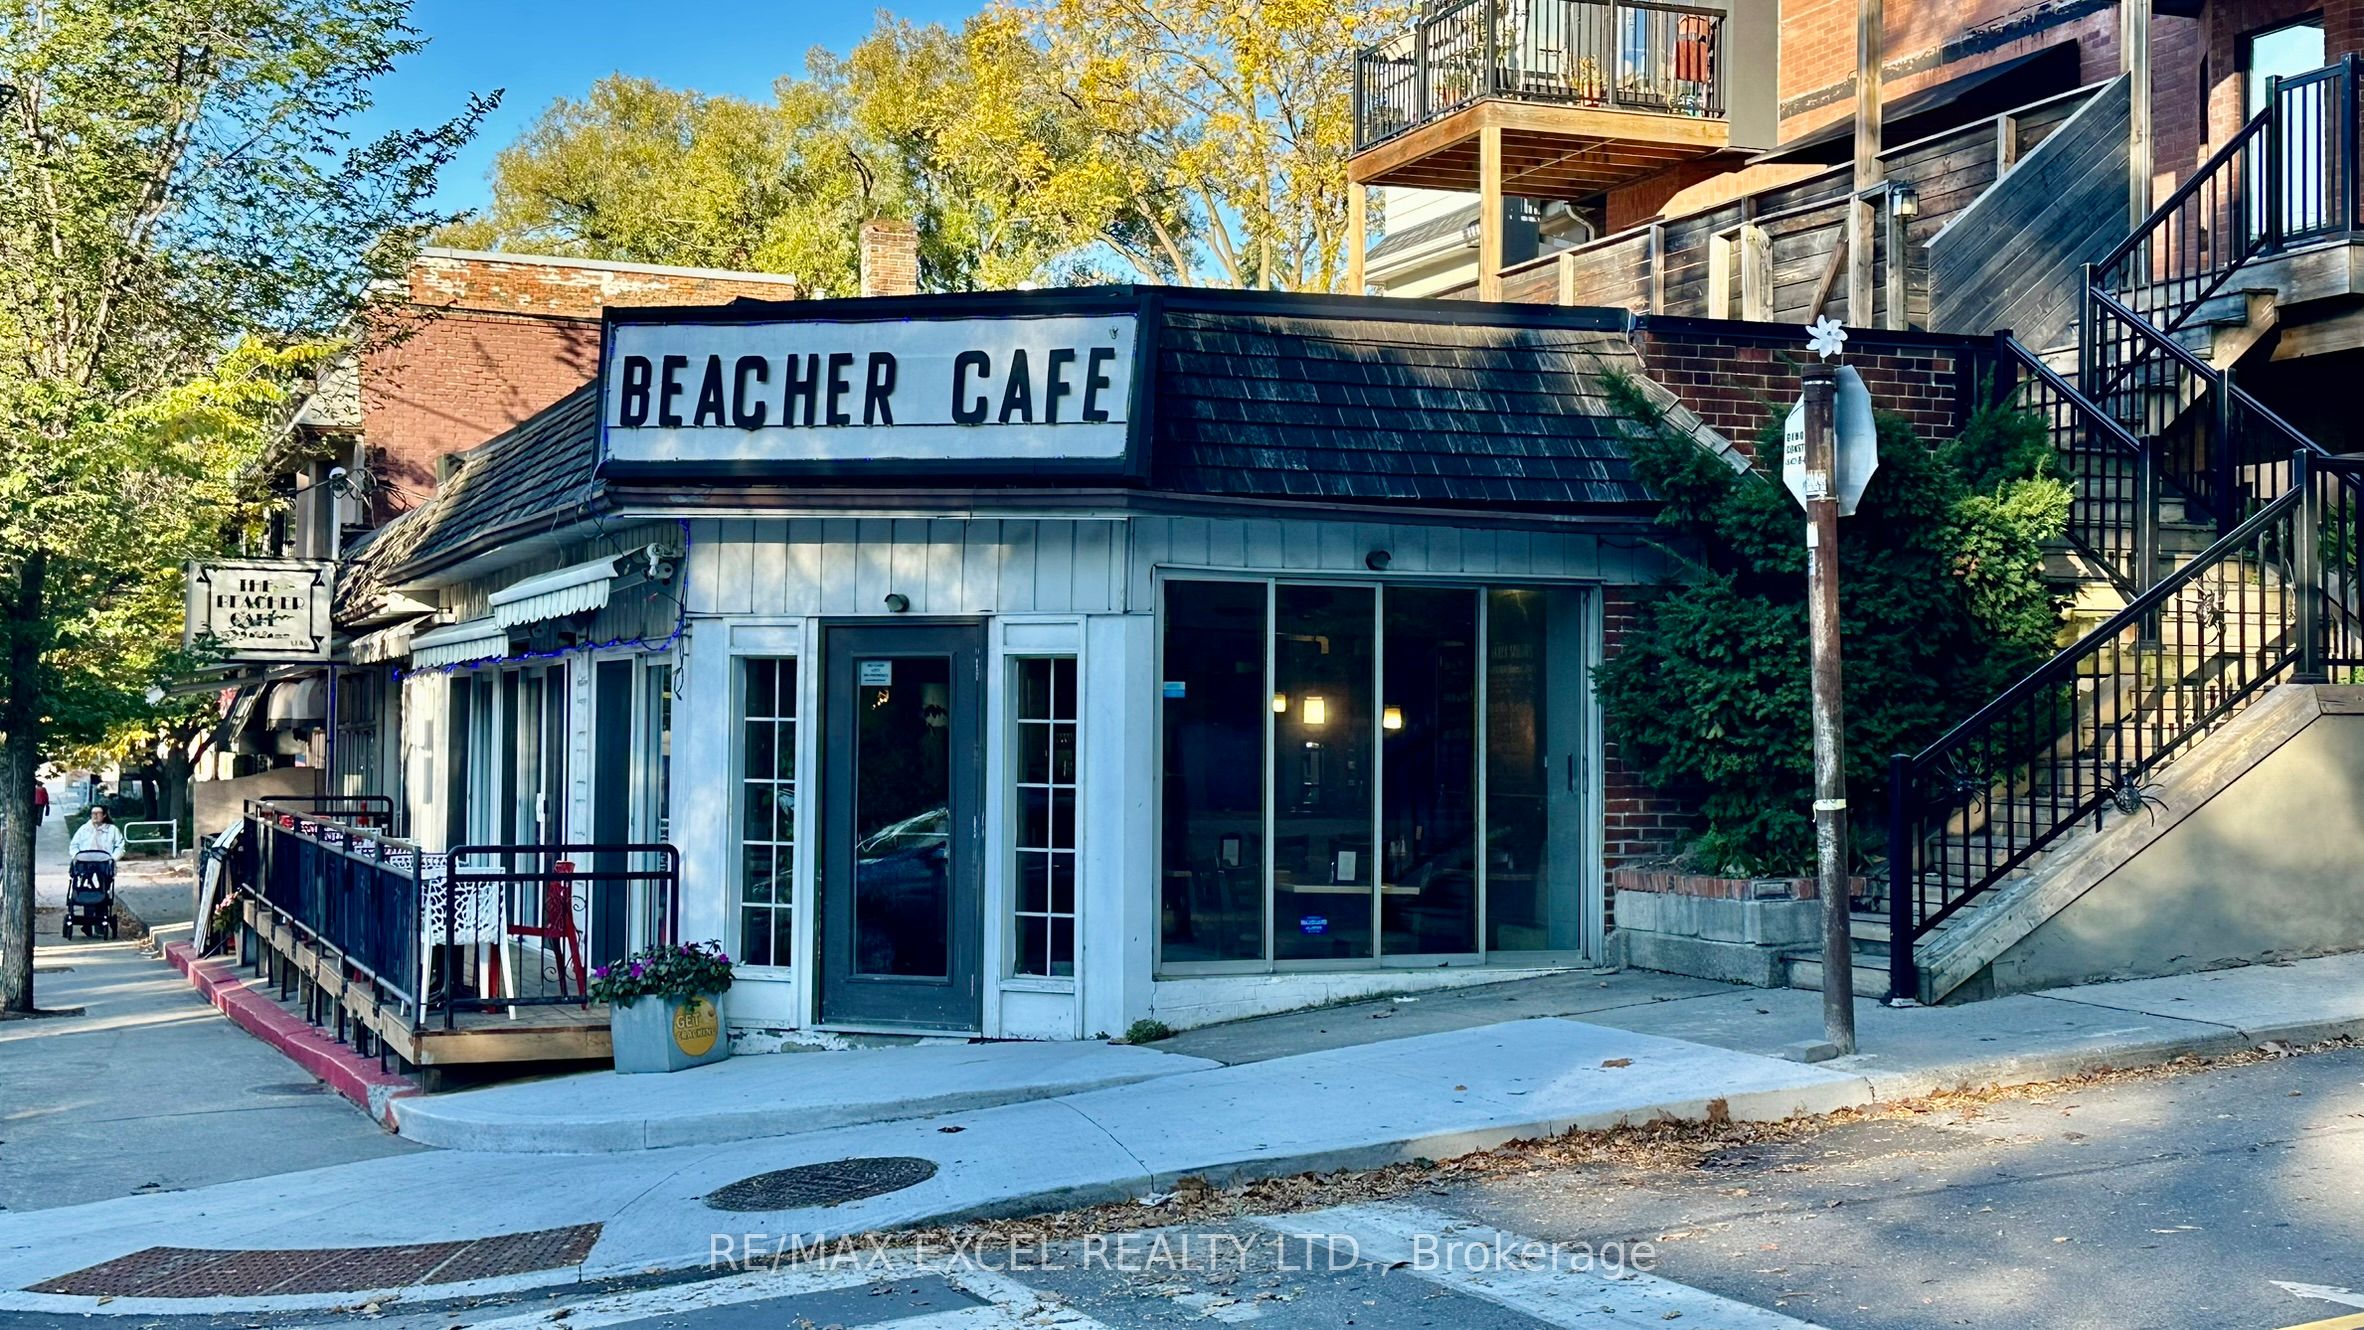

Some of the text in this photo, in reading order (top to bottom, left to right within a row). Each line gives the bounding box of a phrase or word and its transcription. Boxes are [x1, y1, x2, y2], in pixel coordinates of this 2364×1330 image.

[619, 347, 1115, 430] BEACHER CAFE
[240, 579, 274, 592] THE
[216, 595, 305, 611] BEACHER
[676, 1013, 701, 1029] GET
